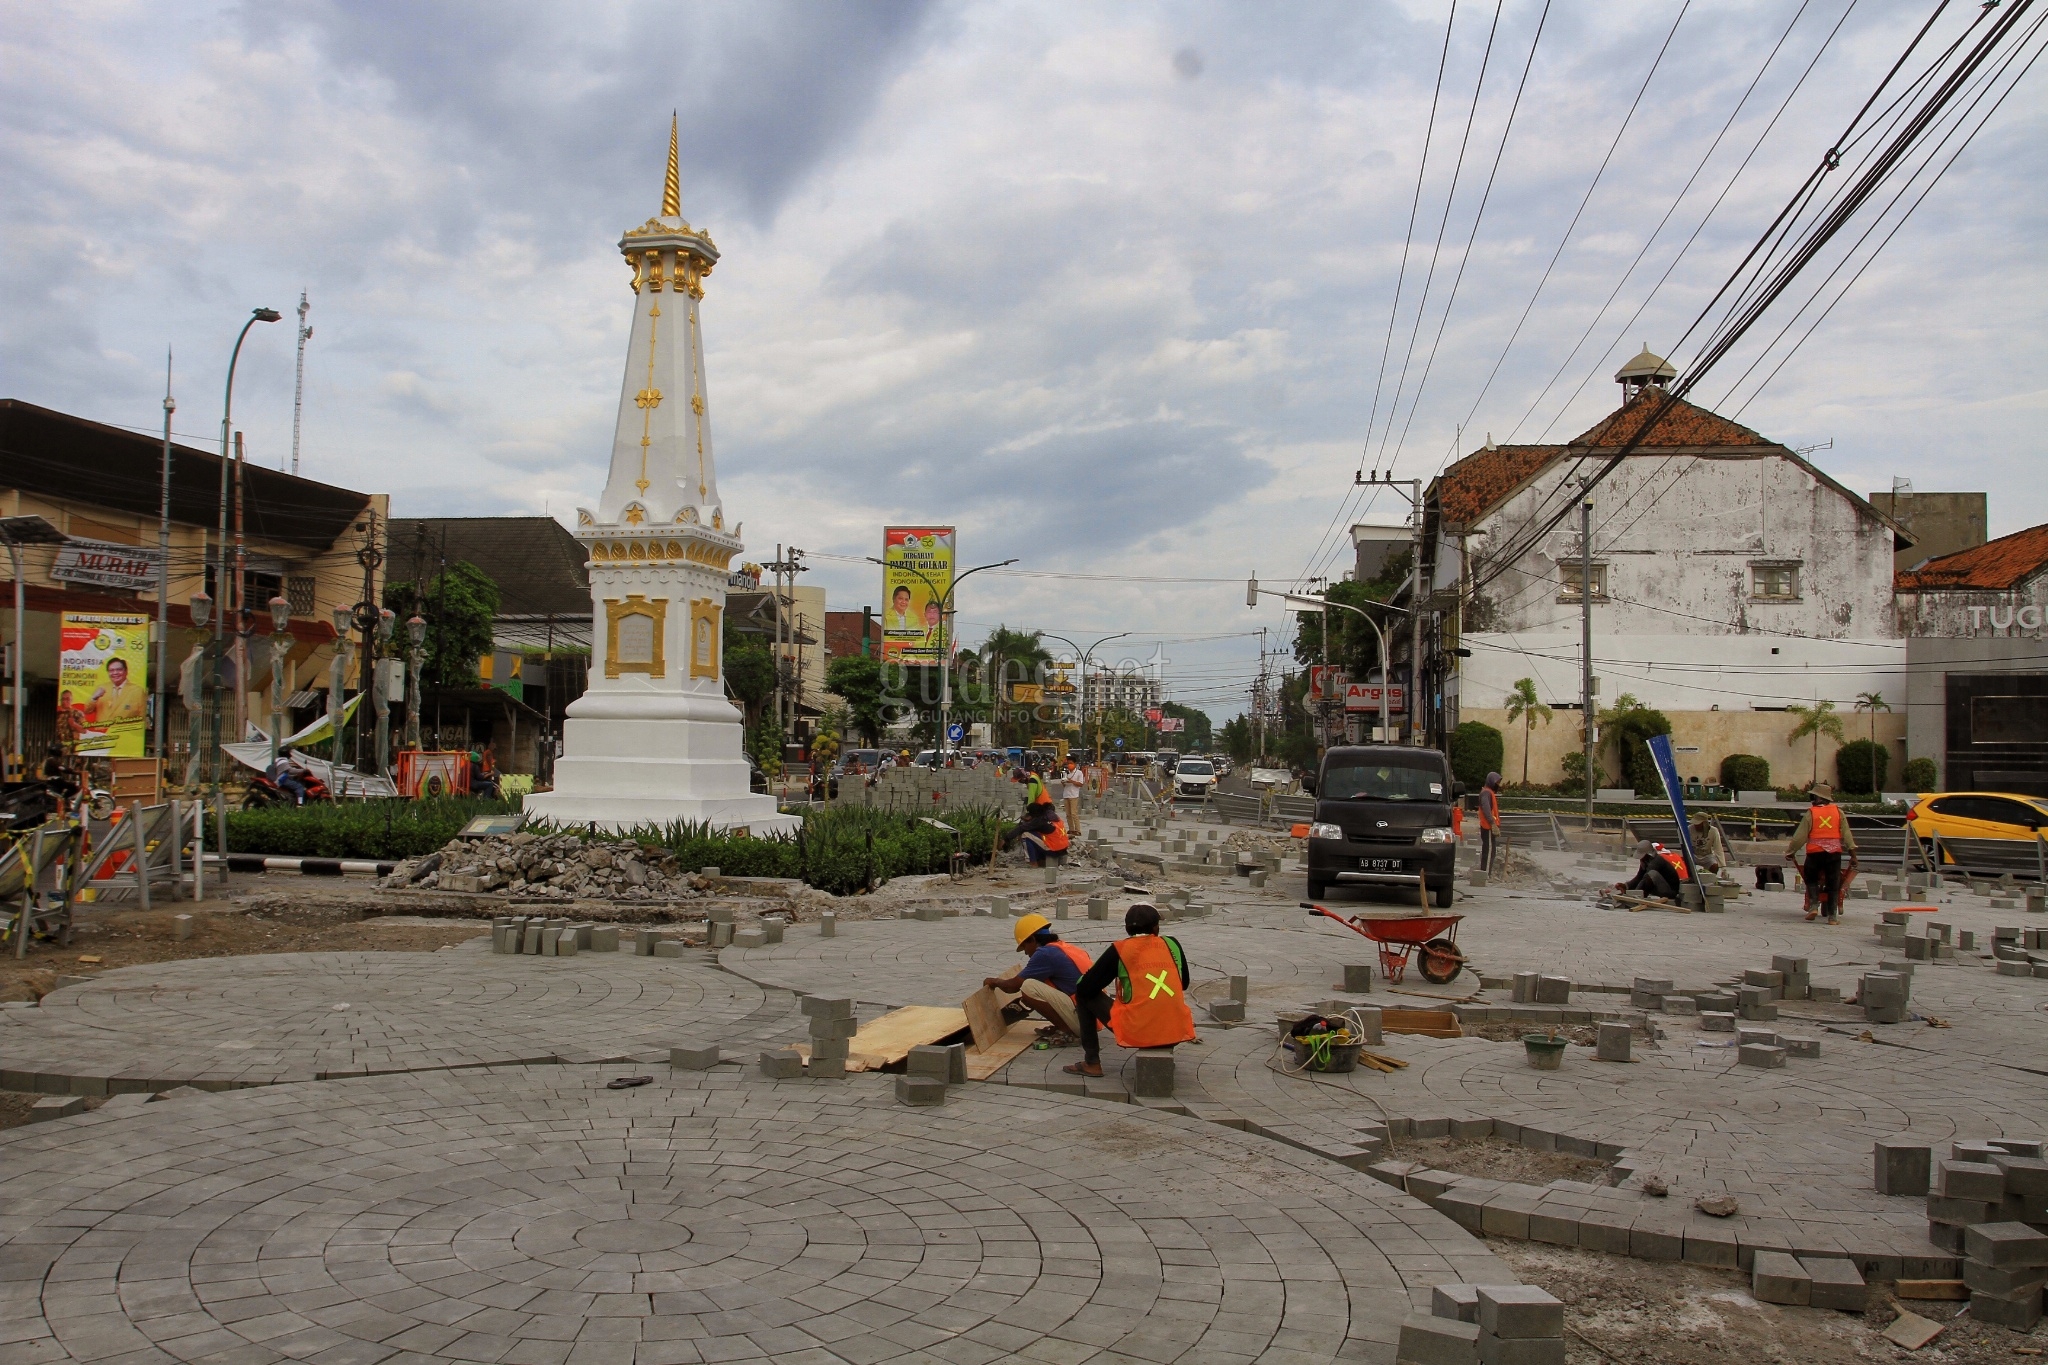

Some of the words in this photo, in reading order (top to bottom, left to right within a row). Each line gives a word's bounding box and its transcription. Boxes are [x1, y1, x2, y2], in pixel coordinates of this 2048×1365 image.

[922, 538, 934, 548] 56
[75, 551, 150, 577] MURAH
[890, 560, 916, 569] PARTAI
[918, 560, 948, 569] GOLKAR
[1967, 605, 2048, 629] TUG
[1360, 859, 1369, 867] AB
[1392, 860, 1401, 868] DT
